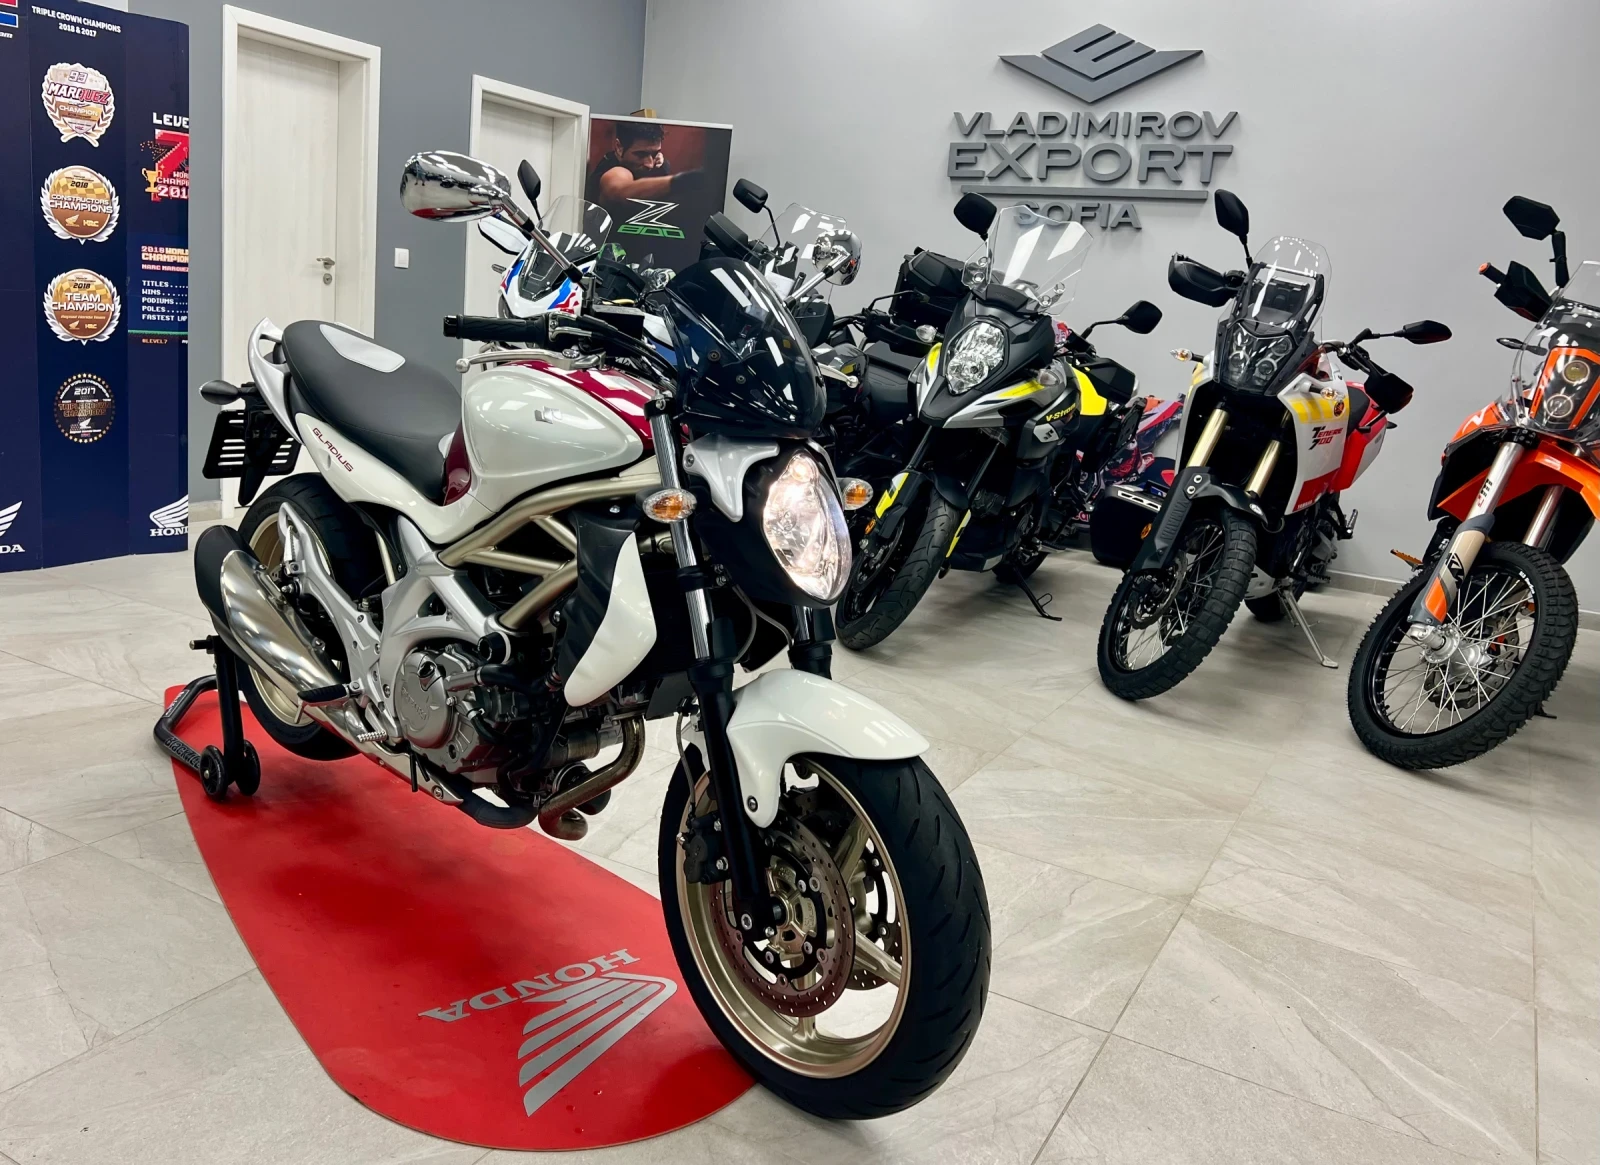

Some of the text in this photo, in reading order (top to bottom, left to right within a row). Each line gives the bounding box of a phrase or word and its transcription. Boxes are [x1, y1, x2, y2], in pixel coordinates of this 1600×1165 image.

[31, 5, 121, 34] TRIPLE CROWN CHAMPIONS
[58, 22, 97, 37] 2018 & 2017
[47, 82, 111, 105] MARQUEZ
[59, 104, 99, 117] CHAMPION
[152, 111, 189, 129] LEVE
[953, 111, 1238, 138] VLADIMIROV
[948, 142, 1234, 184] EXPORT
[70, 181, 89, 189] 2018
[157, 184, 189, 199] 201
[49, 200, 114, 214] CHAMPIONS
[1013, 200, 1142, 230] SOFIA
[65, 292, 101, 302] TEAM
[51, 301, 115, 312] CHAMPION
[142, 313, 175, 321] FASTEST
[312, 427, 354, 472] GLADIUS
[417, 948, 641, 1023] HONDA
